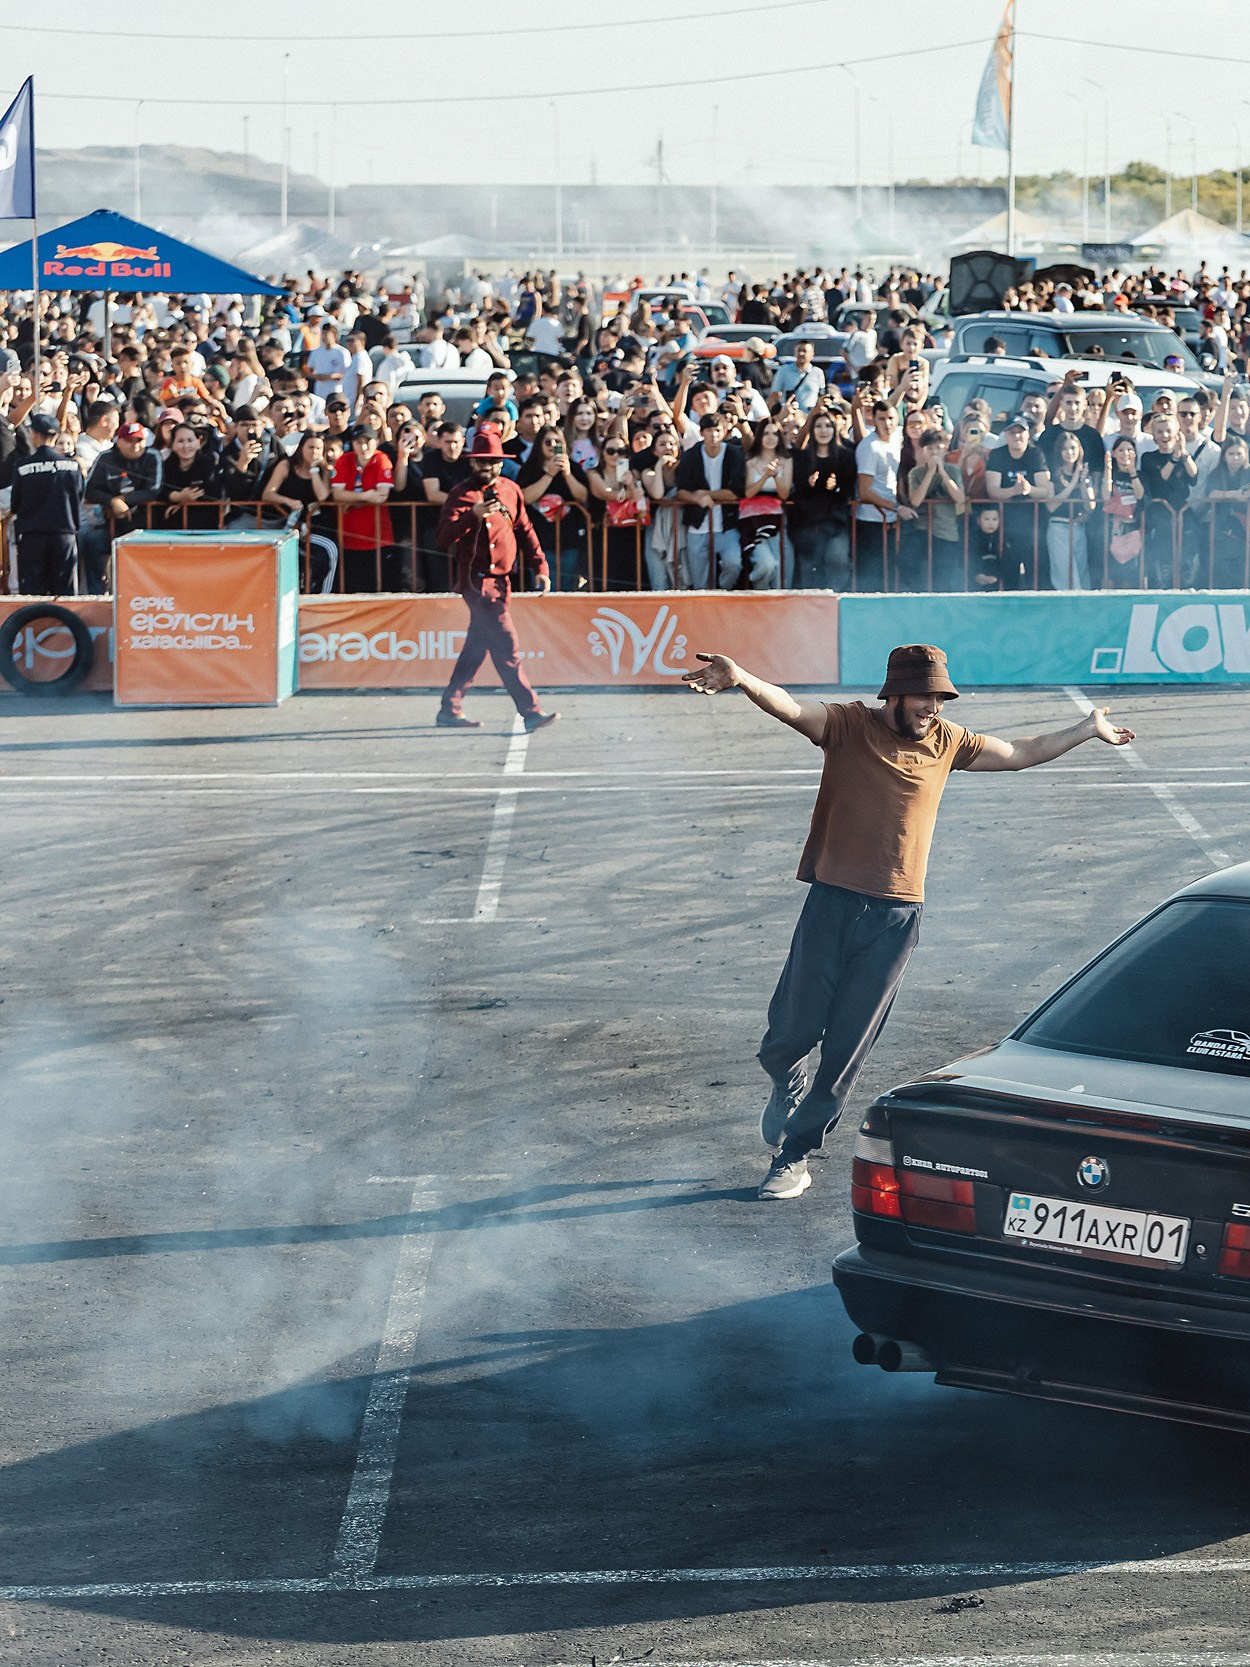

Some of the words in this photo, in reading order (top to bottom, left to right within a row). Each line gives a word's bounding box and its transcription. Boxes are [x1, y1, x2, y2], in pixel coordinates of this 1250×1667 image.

[44, 261, 106, 276] Red
[111, 262, 171, 277] Bull
[1007, 1216, 1026, 1233] KZ
[1147, 1221, 1184, 1257] 01
